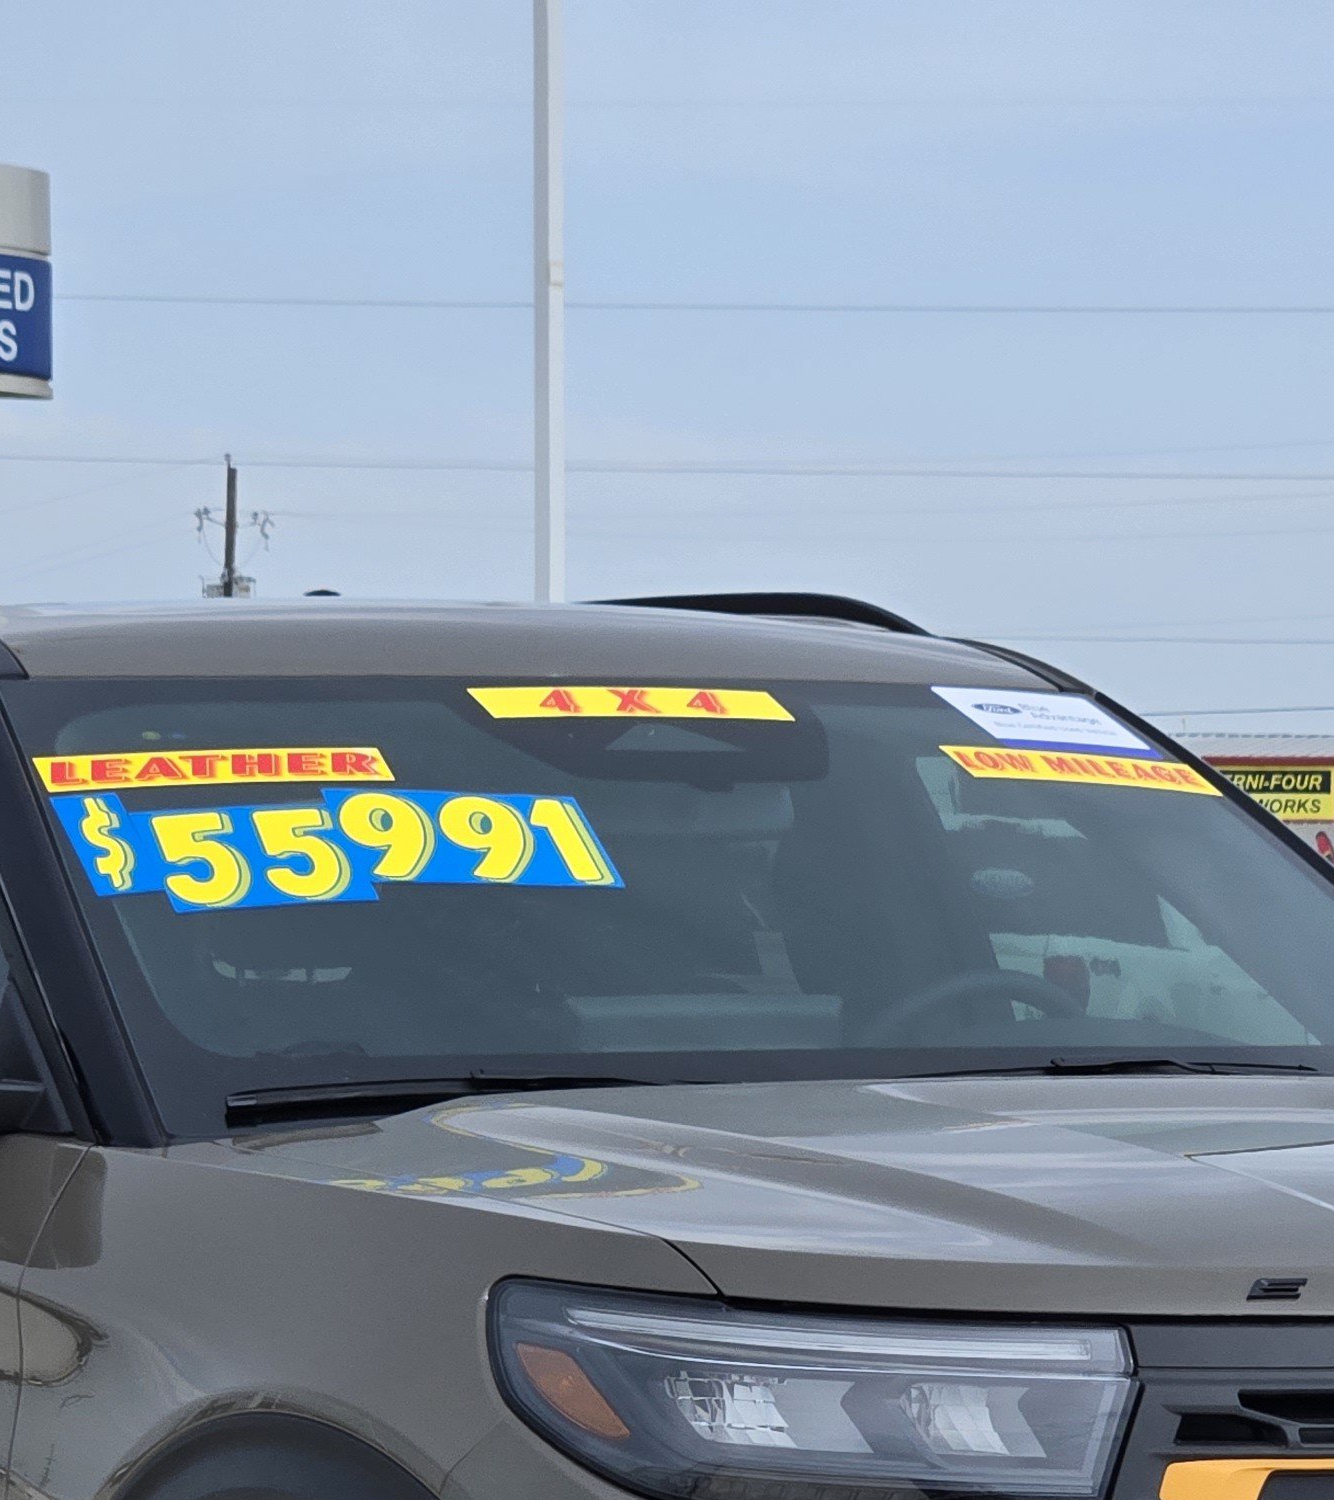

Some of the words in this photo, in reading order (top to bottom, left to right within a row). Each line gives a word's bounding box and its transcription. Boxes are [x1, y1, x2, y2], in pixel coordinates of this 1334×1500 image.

[50, 750, 382, 785] LEATHER
[953, 750, 1033, 772] LOW
[1040, 755, 1200, 785] MILEAGE
[80, 792, 614, 908] $55991
